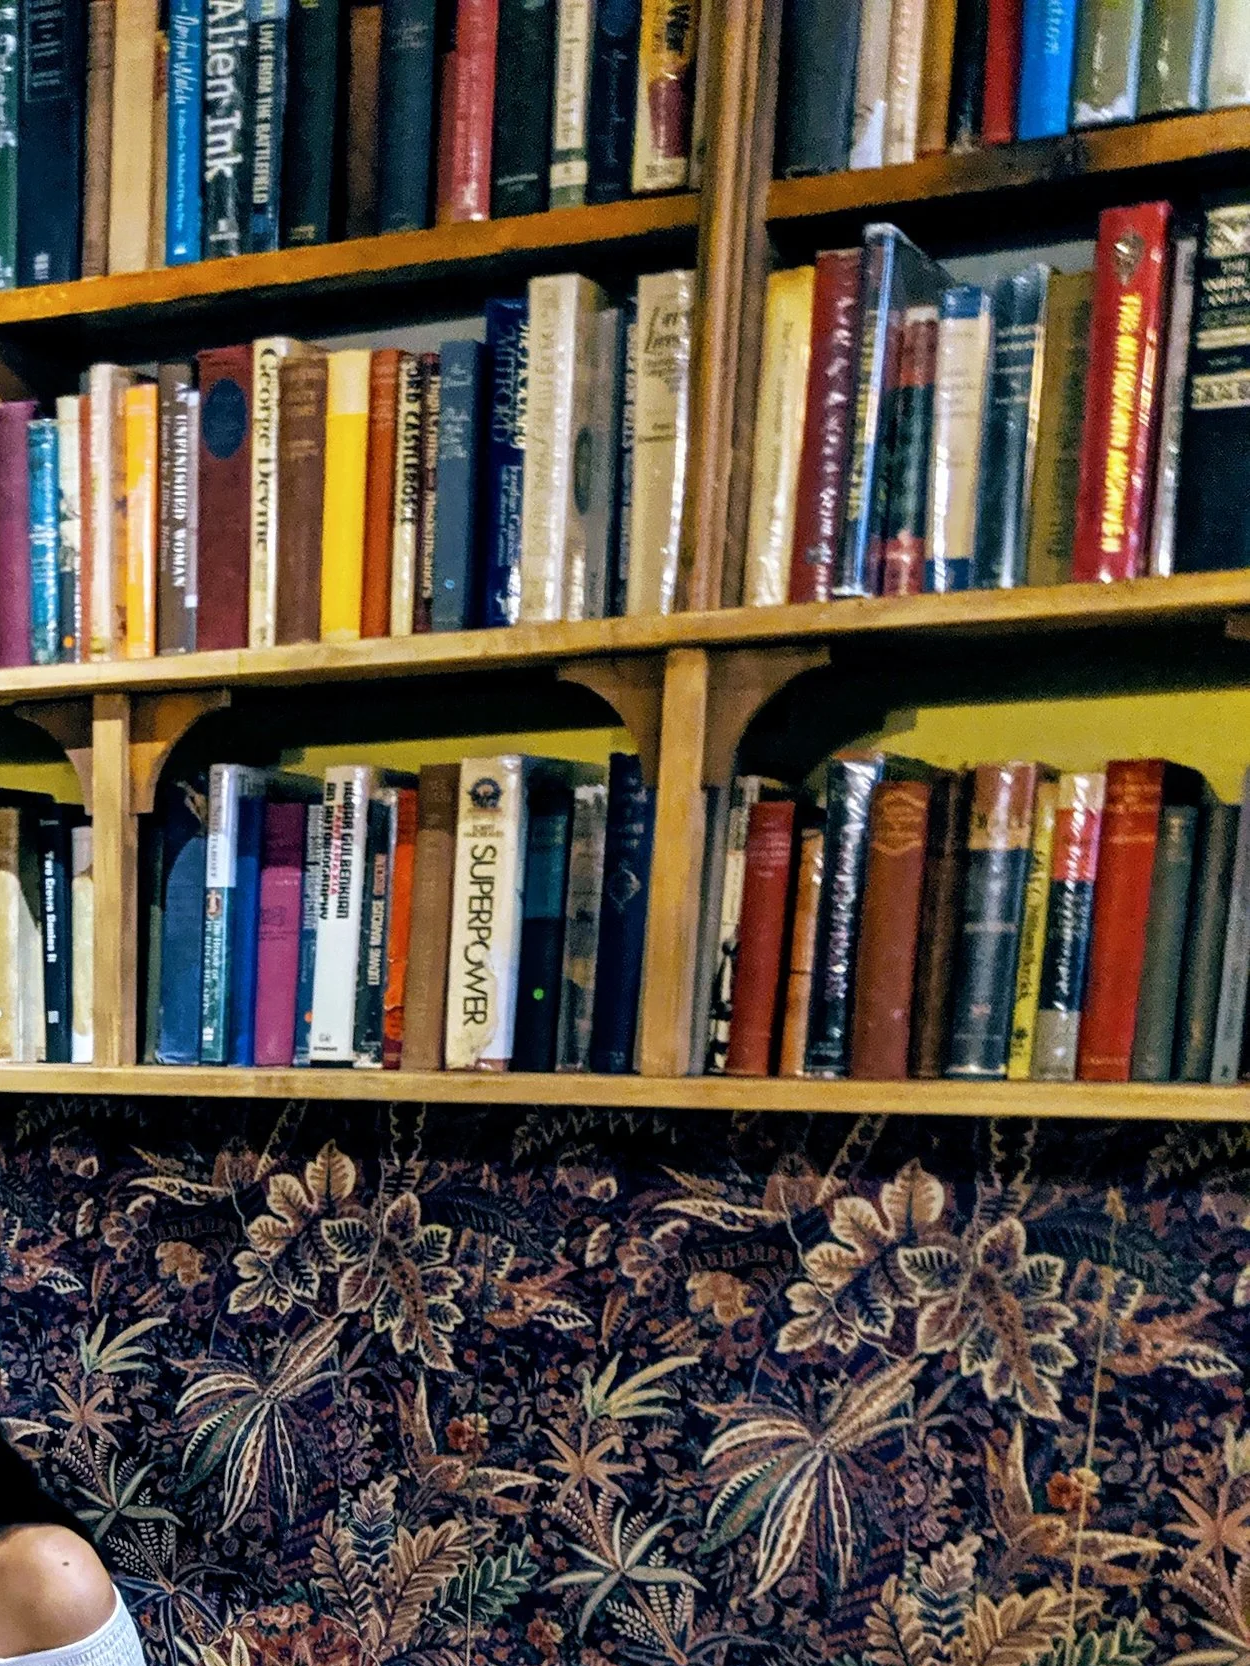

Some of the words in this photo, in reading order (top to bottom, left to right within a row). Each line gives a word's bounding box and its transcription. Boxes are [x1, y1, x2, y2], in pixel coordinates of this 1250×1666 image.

[205, 0, 247, 103] Alien
[257, 23, 274, 51] LIVE
[255, 54, 273, 94] FROM
[254, 97, 272, 121] THE
[202, 109, 243, 183] Ink
[250, 122, 271, 204] BATTLEFIELD
[172, 381, 190, 404] AN
[252, 348, 278, 448] George
[169, 414, 187, 521] UNFINISHED
[255, 456, 275, 553] Devine
[169, 527, 187, 588] WOMAN
[324, 782, 337, 803] AN
[43, 850, 55, 876] Two
[43, 877, 58, 913] Crows
[318, 805, 335, 921] AUTOBIOGRAPHY
[334, 832, 352, 920] GULBENKIAN
[45, 914, 59, 952] Denies
[461, 844, 497, 1027] SUPERPOWER
